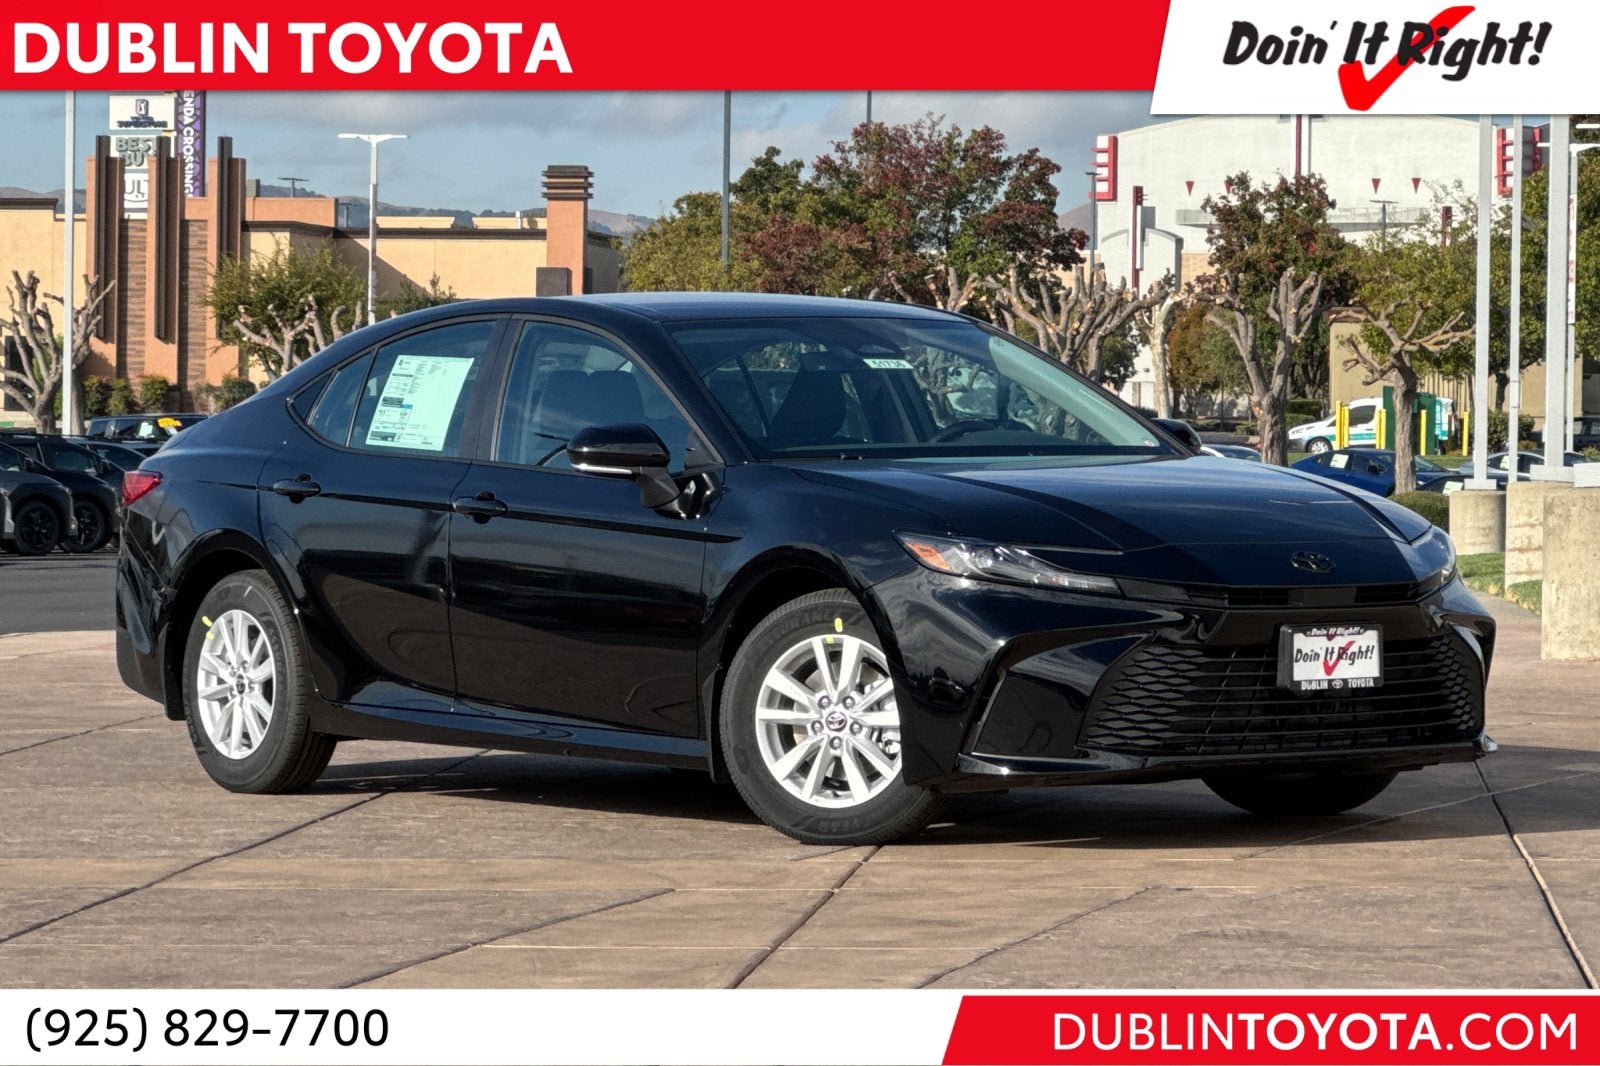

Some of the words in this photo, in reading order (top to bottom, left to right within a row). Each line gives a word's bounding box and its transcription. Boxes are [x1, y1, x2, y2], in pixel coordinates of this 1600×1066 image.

[1324, 646, 1335, 661] It
[1338, 645, 1375, 666] Right!
[1301, 680, 1328, 690] DUBLIN
[1347, 678, 1374, 688] TOYOTA
